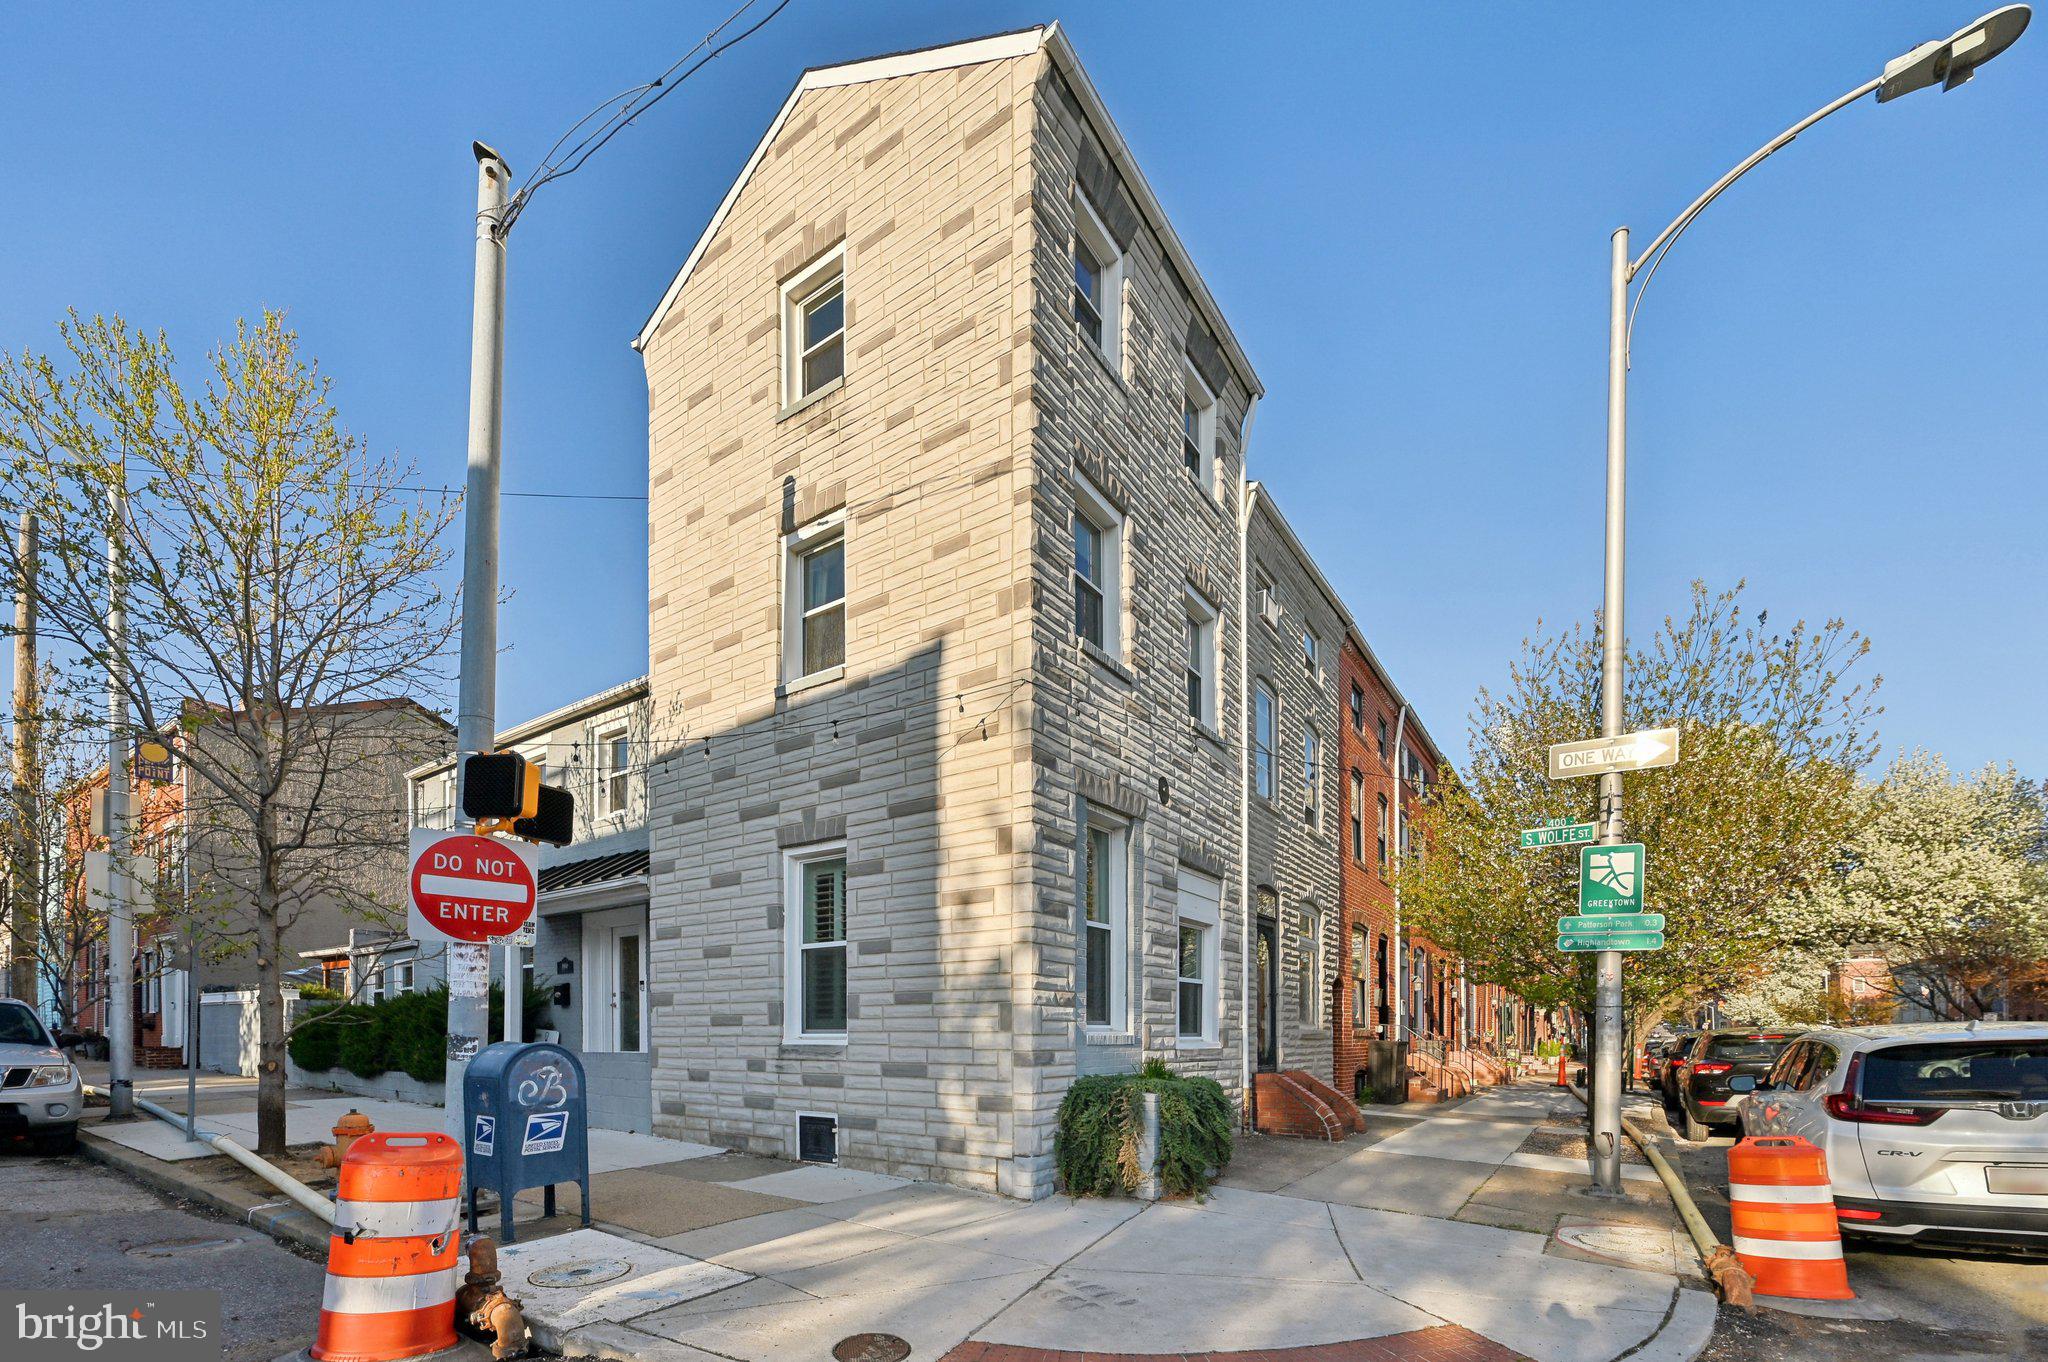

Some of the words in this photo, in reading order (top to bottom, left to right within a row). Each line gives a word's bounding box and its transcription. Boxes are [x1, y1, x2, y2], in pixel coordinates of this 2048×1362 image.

[1563, 751, 1595, 767] ONE
[1602, 746, 1633, 762] WAY
[1548, 818, 1567, 827] 400
[1526, 833, 1536, 845] S.
[1538, 829, 1577, 844] WOLFE
[1578, 828, 1591, 838] ST.
[434, 852, 463, 871] DO
[476, 858, 516, 877] NOT
[1587, 898, 1636, 908] GREEKTOWN
[439, 901, 509, 923] ENTER
[1577, 920, 1613, 929] Patterson
[1615, 919, 1633, 928] Park
[1644, 918, 1658, 927] 0.3
[1577, 937, 1631, 949] Highlandtown
[1877, 1149, 1924, 1157] CR-V
